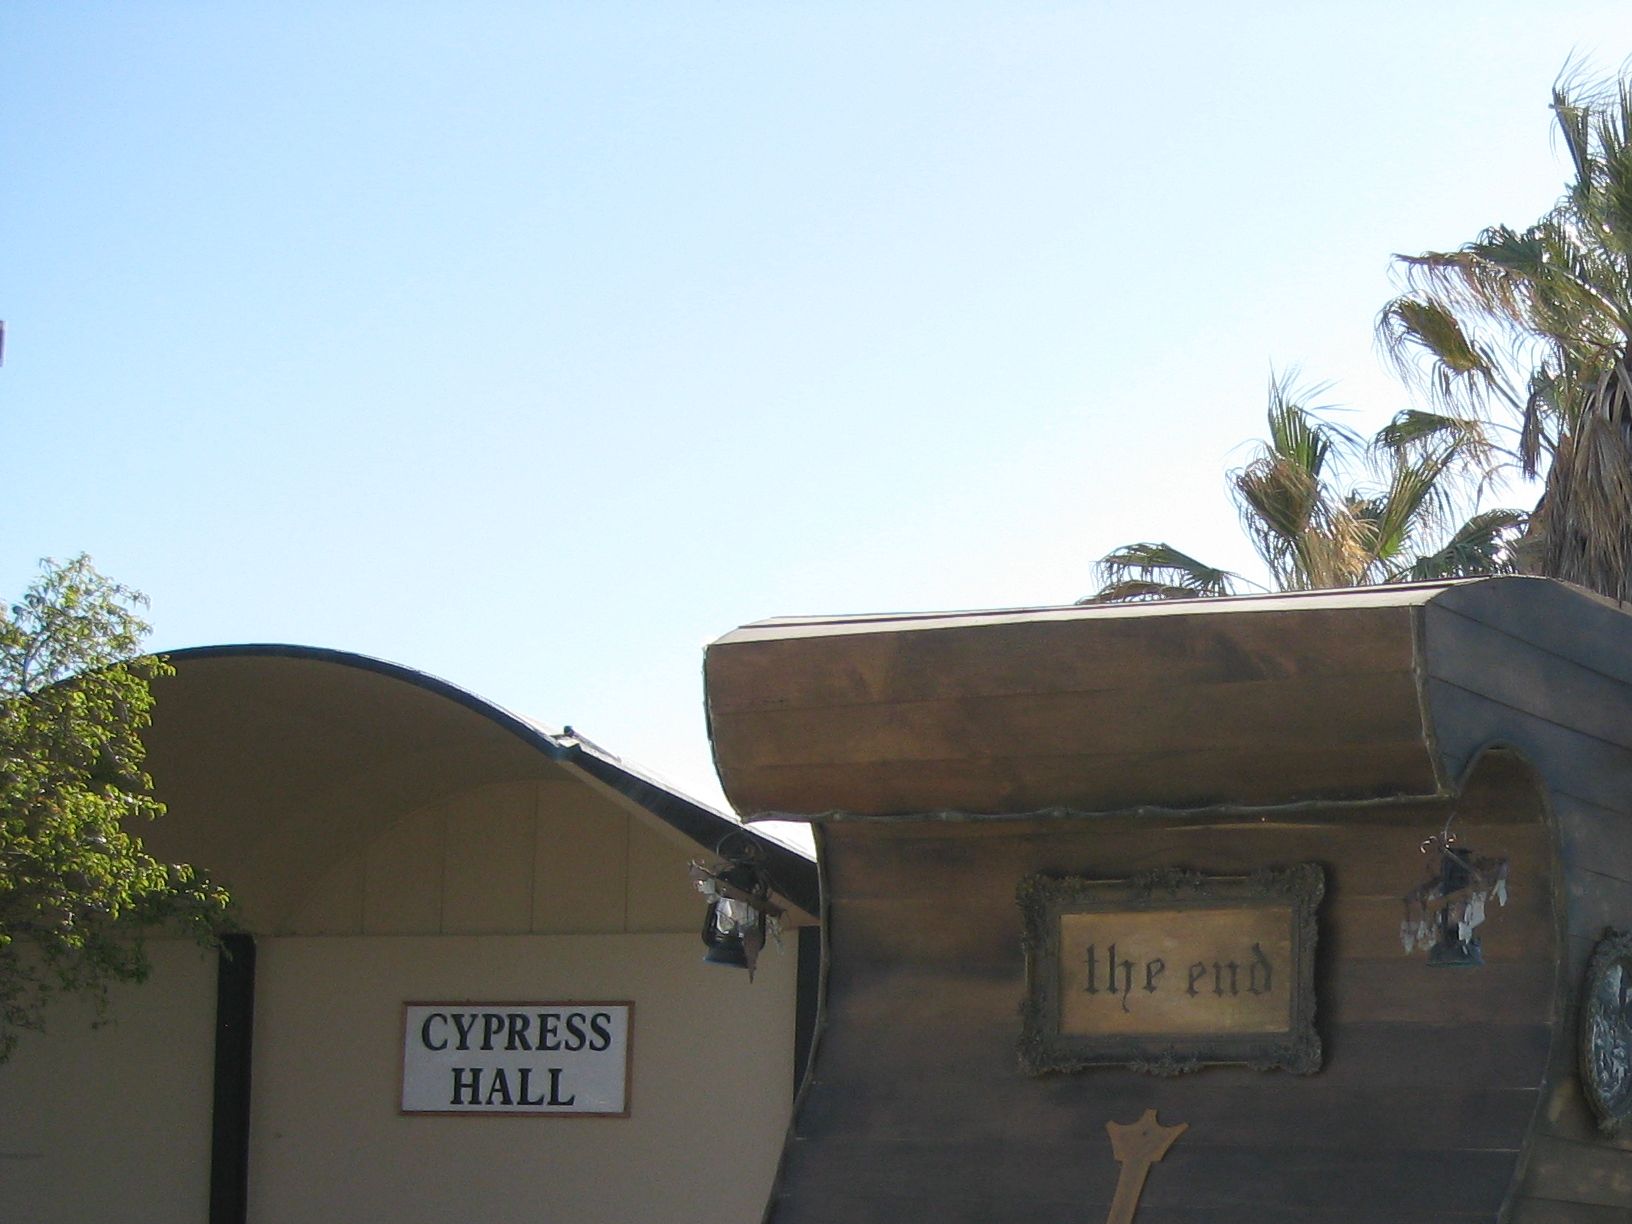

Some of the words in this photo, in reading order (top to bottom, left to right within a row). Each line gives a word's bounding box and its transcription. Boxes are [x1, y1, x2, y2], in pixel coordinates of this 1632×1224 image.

[1083, 943, 1167, 1013] the
[1186, 942, 1274, 998] end
[421, 1013, 611, 1051] CYPRESS
[450, 1067, 575, 1106] HALL
